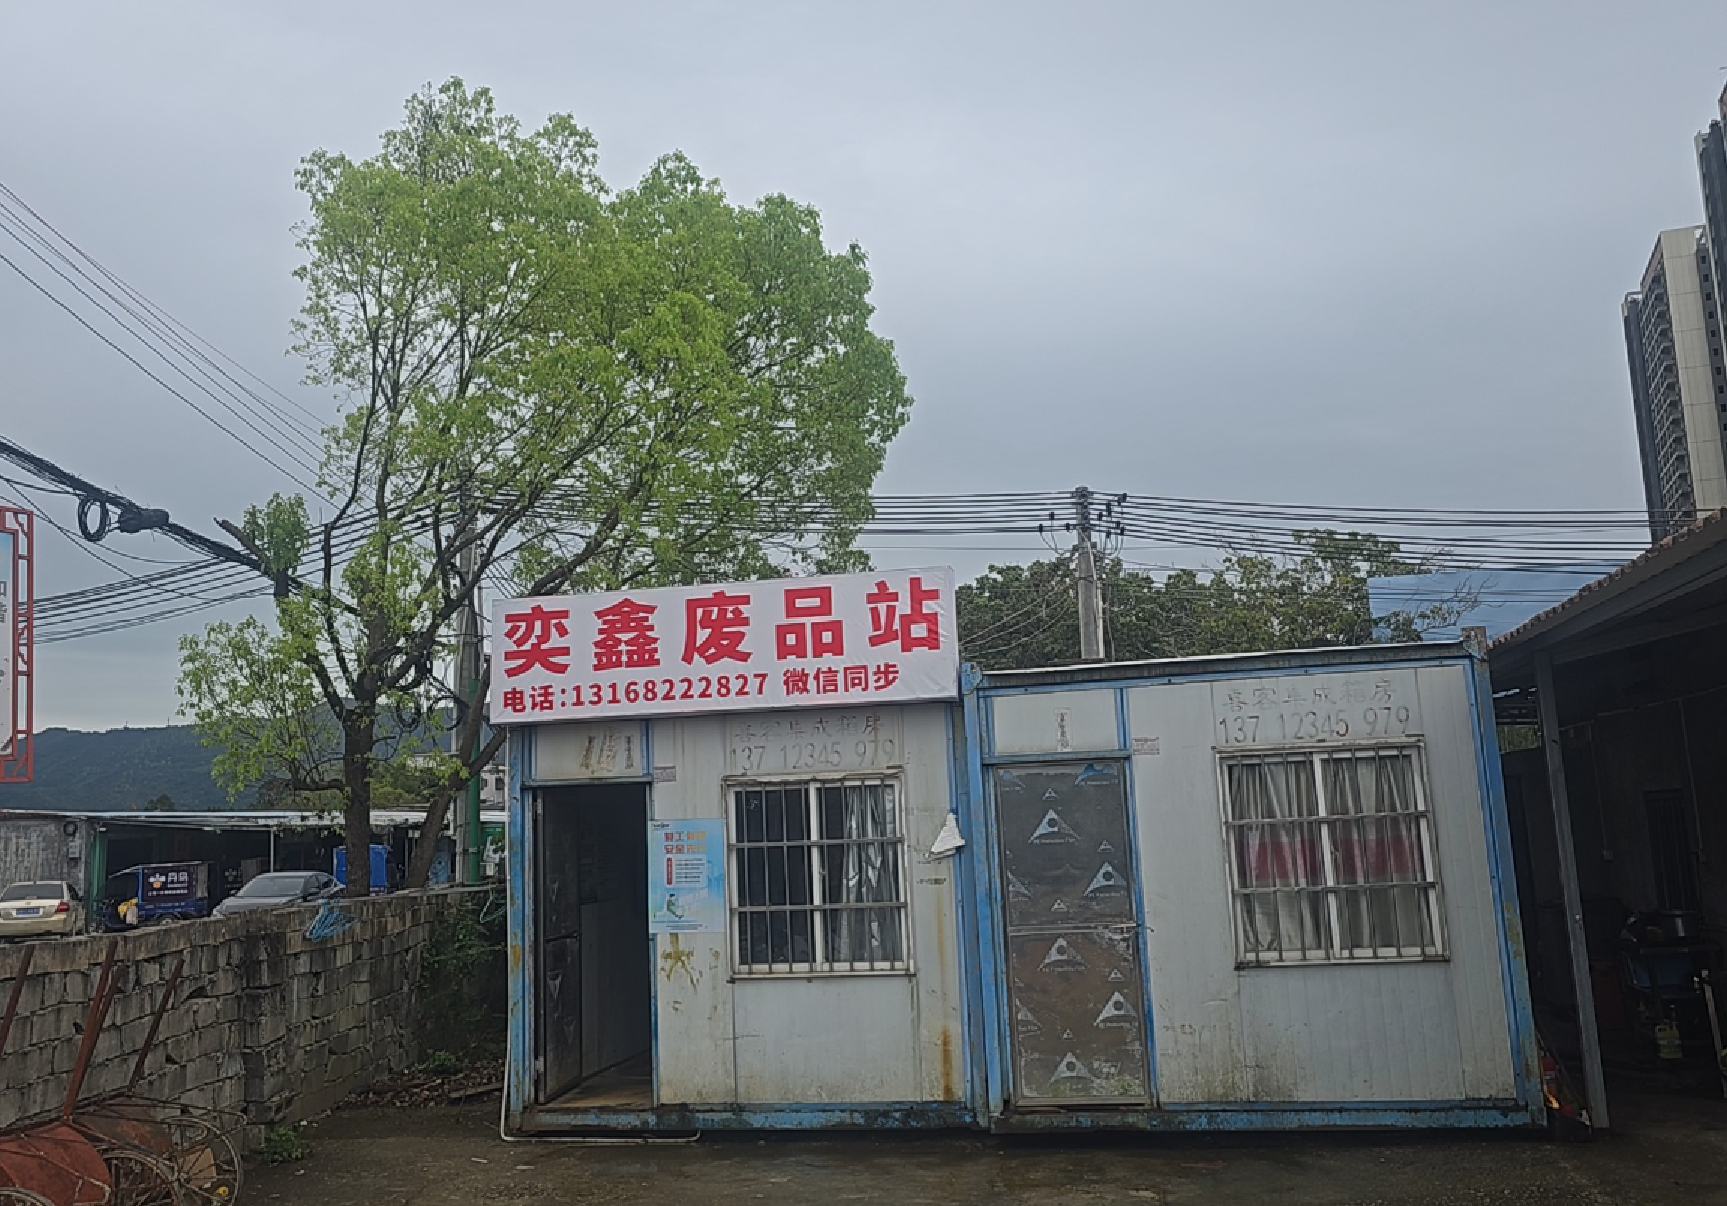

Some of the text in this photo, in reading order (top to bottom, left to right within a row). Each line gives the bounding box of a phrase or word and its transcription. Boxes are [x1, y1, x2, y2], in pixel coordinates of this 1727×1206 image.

[504, 576, 940, 678] 奕鑫废品站
[783, 662, 900, 697] 微信同步
[1219, 705, 1410, 744] 137 12345 979
[730, 738, 895, 771] 137 12345 979
